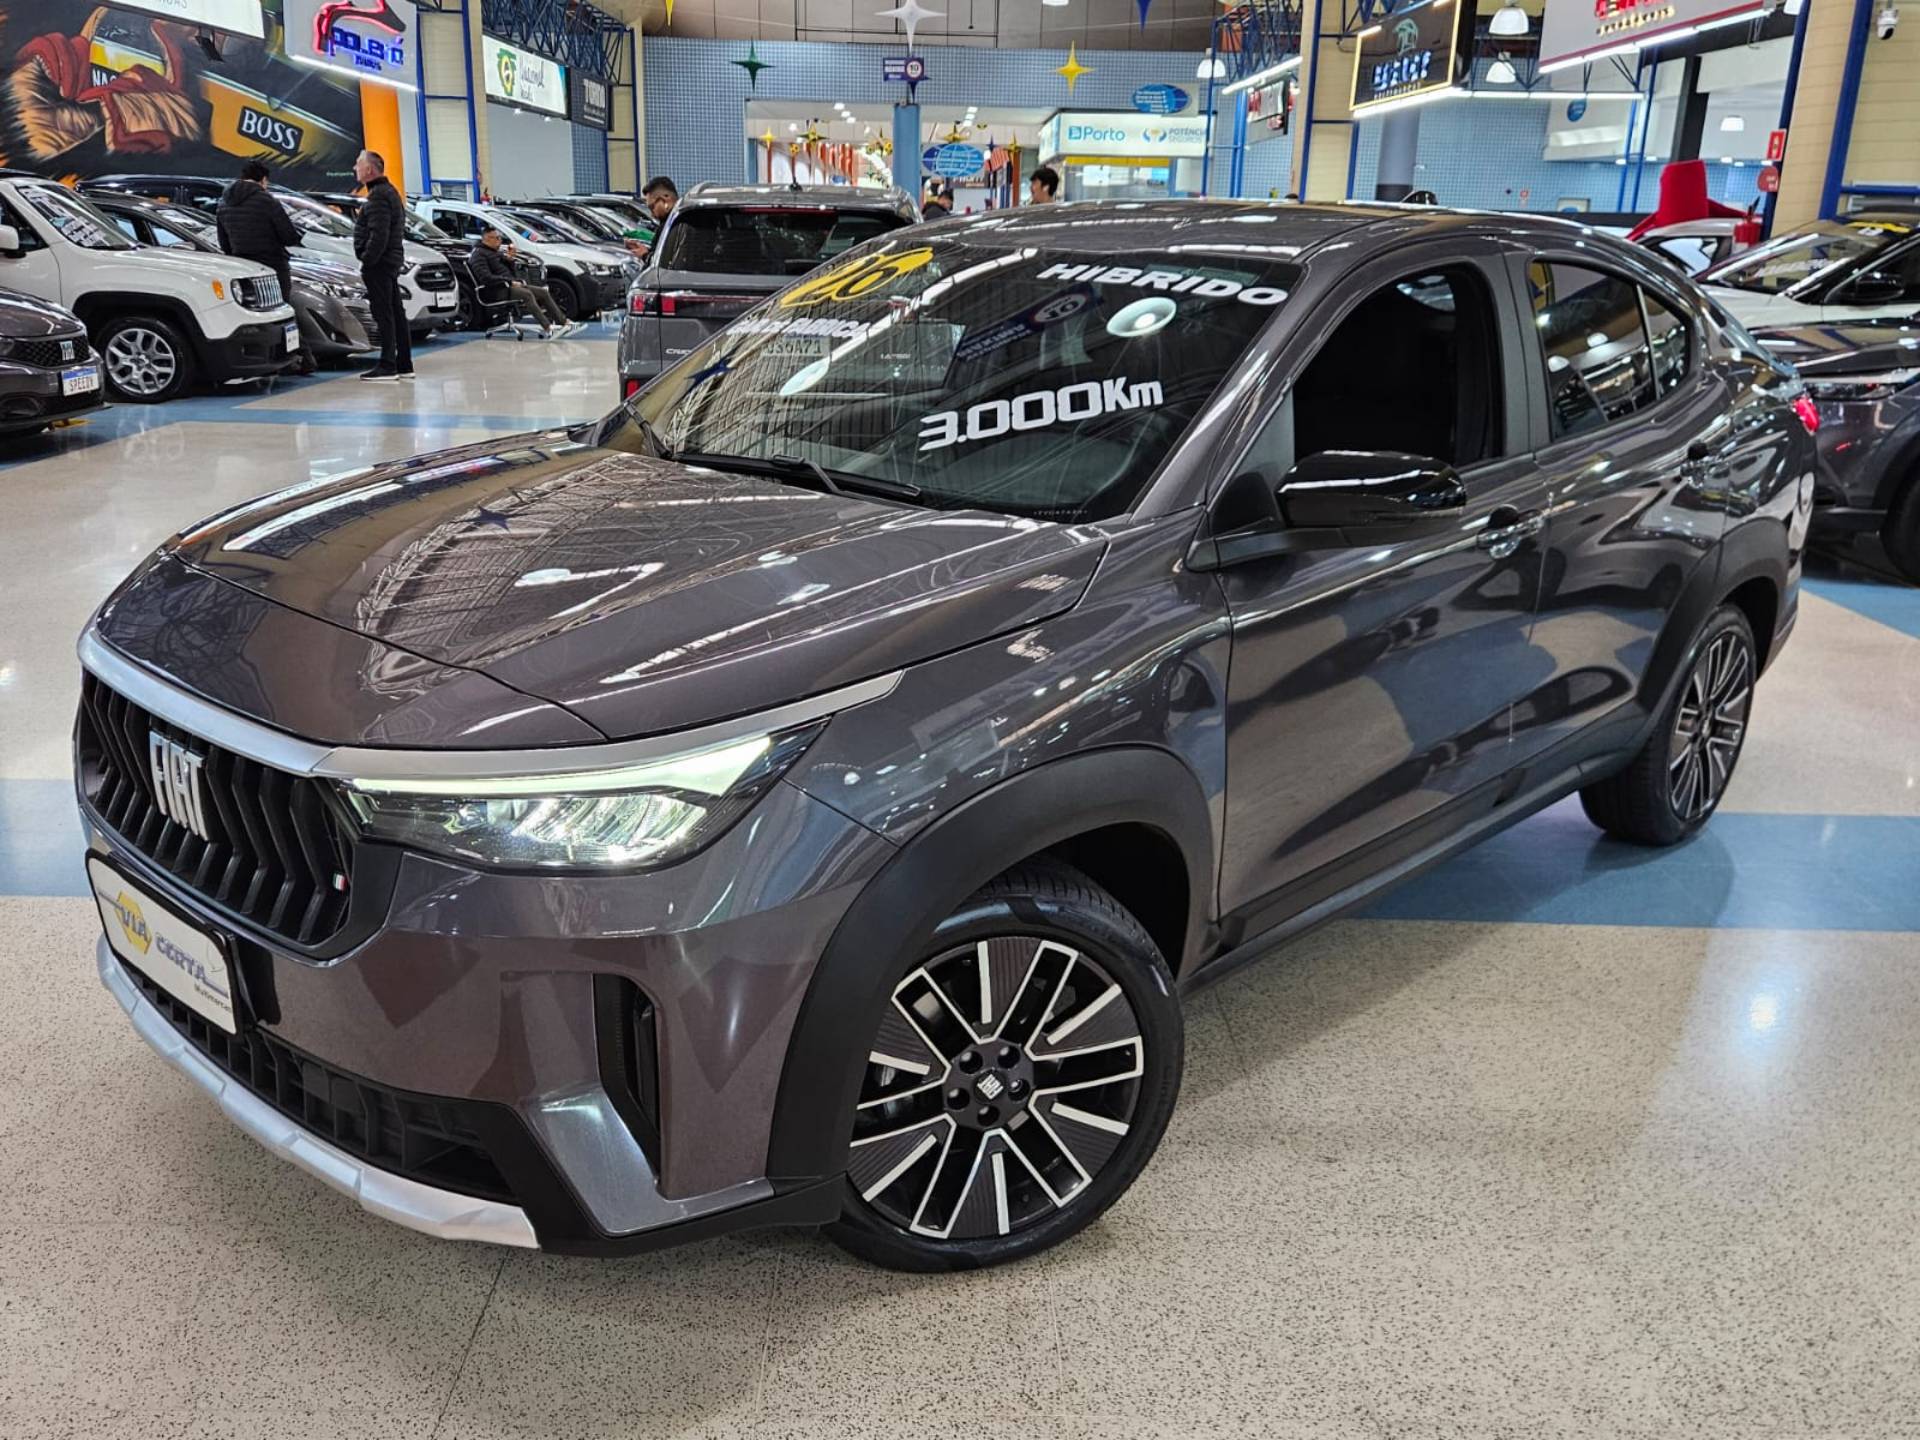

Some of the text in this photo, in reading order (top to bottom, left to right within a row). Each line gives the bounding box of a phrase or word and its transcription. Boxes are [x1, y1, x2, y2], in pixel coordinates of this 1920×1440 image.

[241, 109, 298, 150] BOSS
[1084, 126, 1126, 141] Porto
[1036, 263, 1289, 305] HIBRIDO
[150, 730, 209, 842] FIAT
